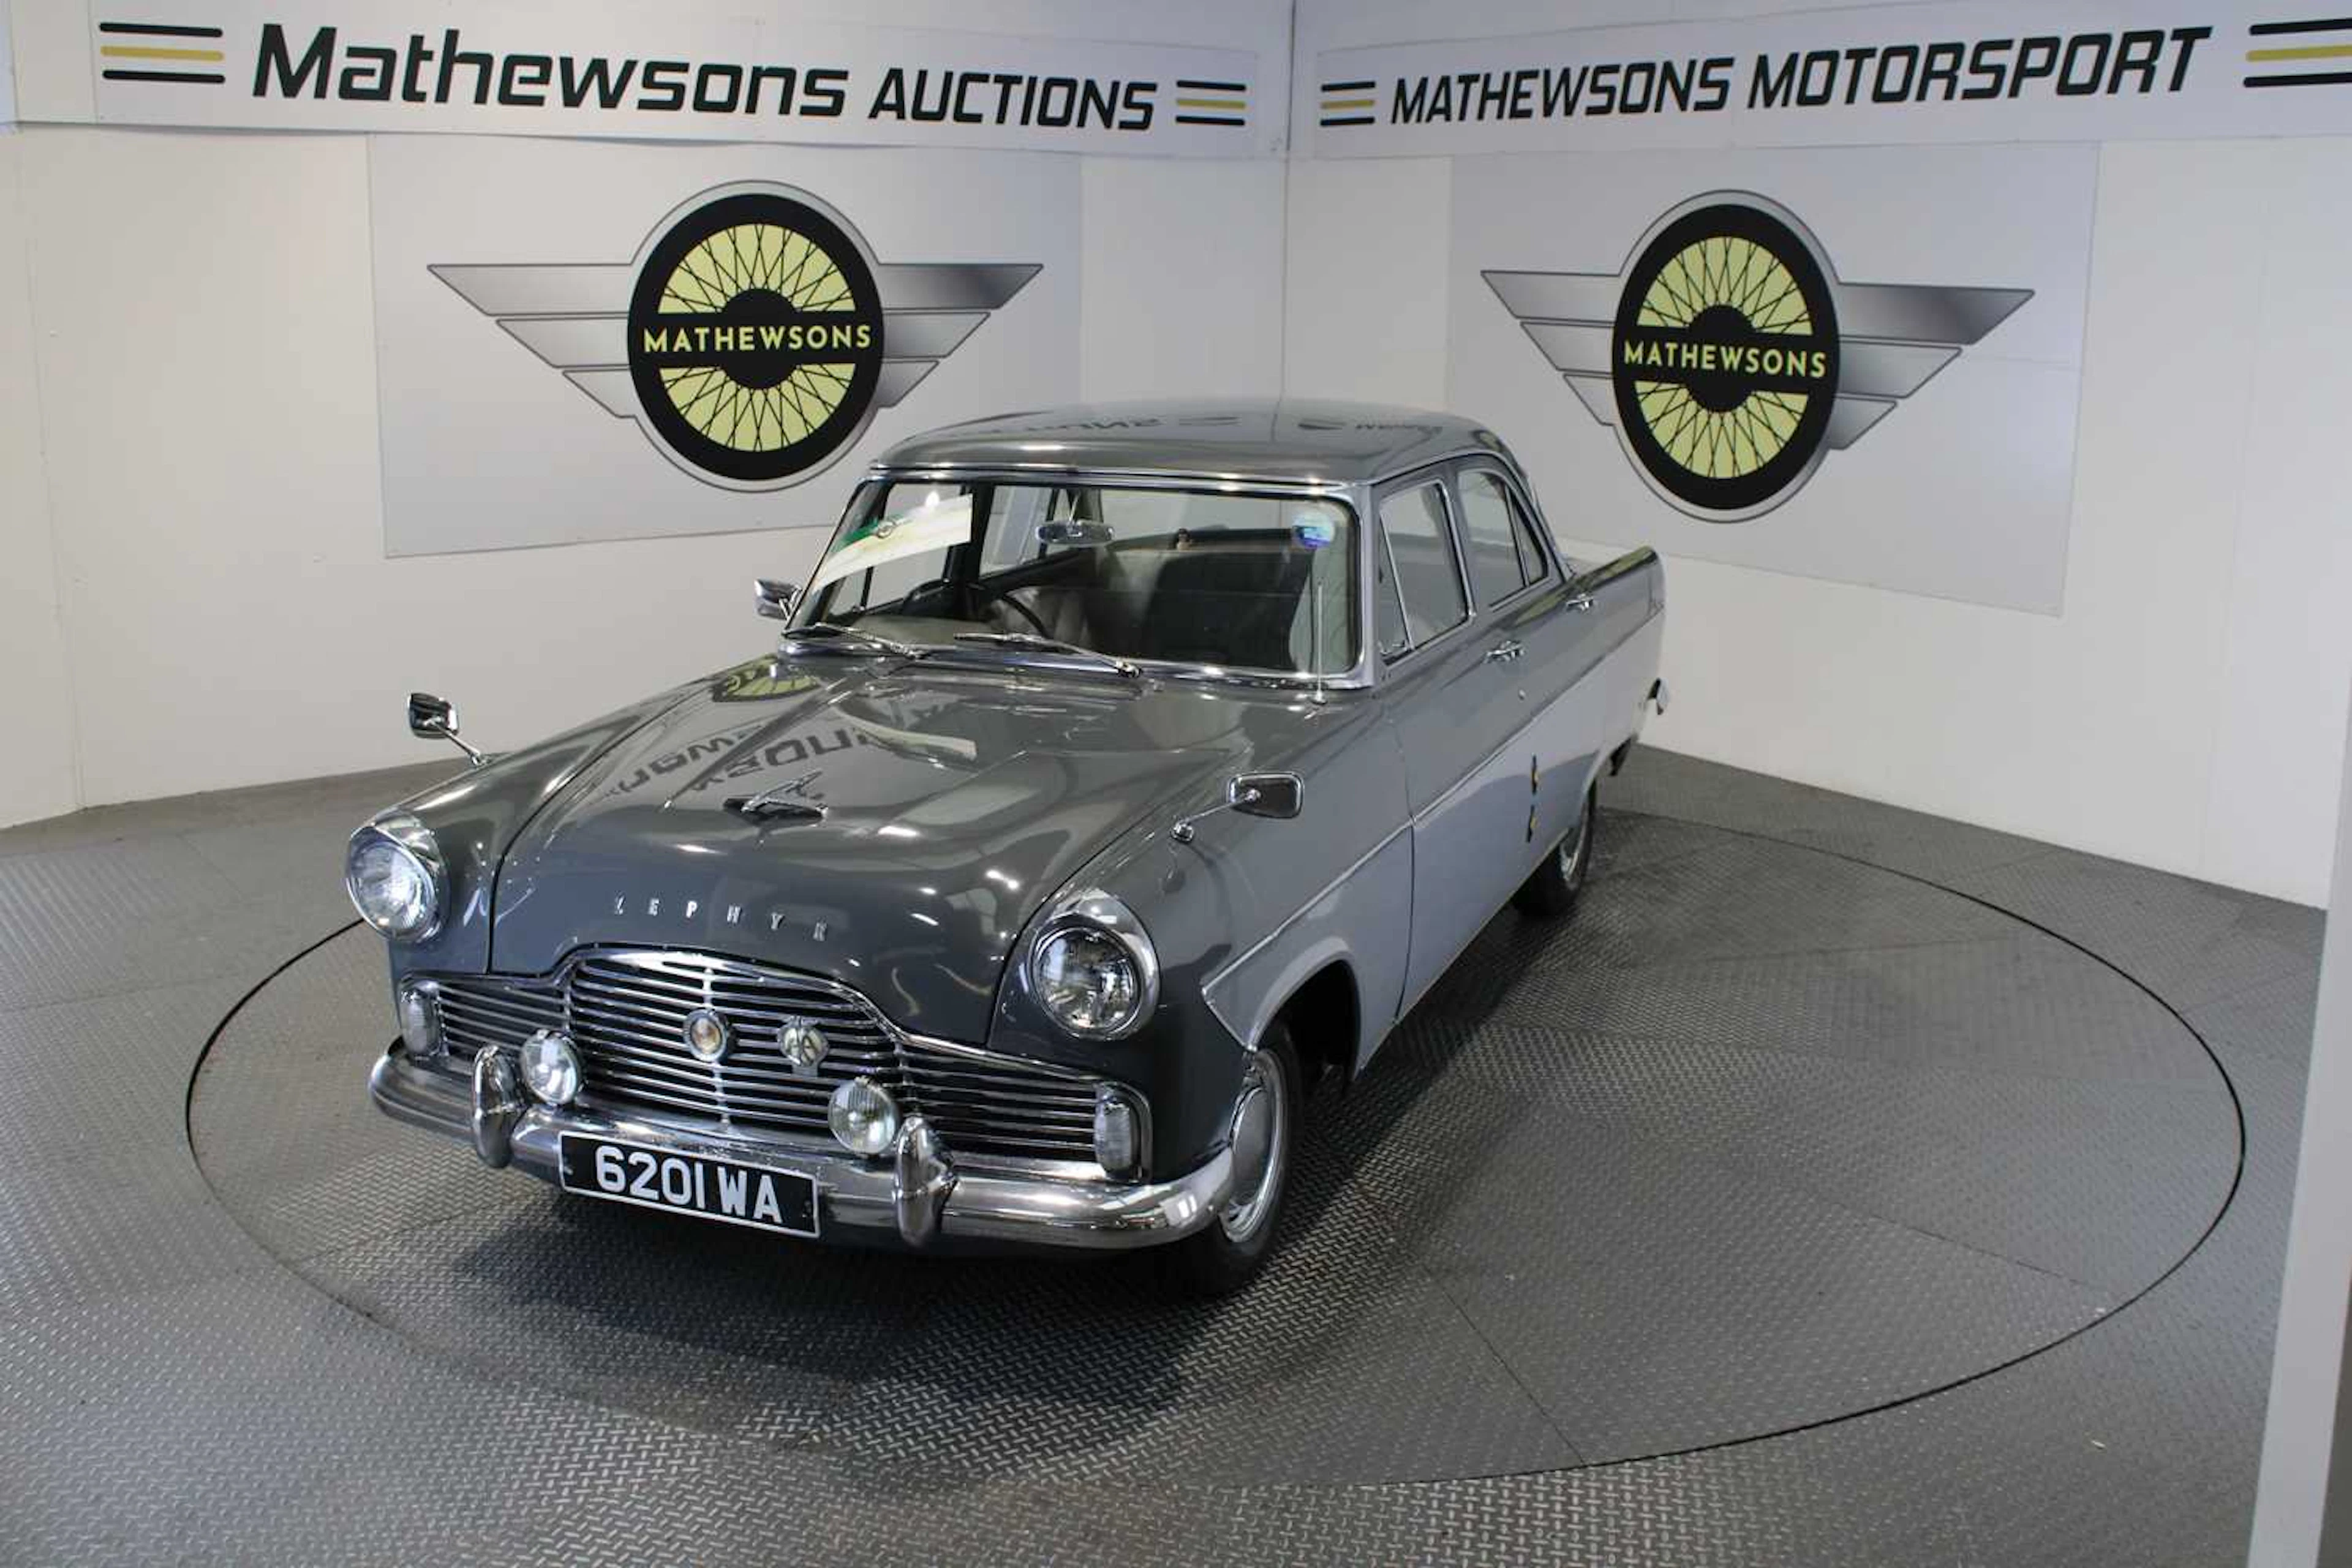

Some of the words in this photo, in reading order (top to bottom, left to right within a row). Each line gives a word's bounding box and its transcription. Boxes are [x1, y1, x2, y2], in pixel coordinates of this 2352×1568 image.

[253, 24, 848, 116] Mathewsons
[868, 68, 1158, 131] AUCTIONS
[1391, 57, 1735, 124] MATHEWSONS
[1747, 26, 2212, 108] MOTORSPORT
[643, 325, 870, 353] MATHEWSONS
[1623, 341, 1826, 379] MATHEWSONS
[615, 895, 827, 941] ZEPHYR
[597, 1146, 704, 1208] 6201
[718, 1167, 782, 1223] WA
